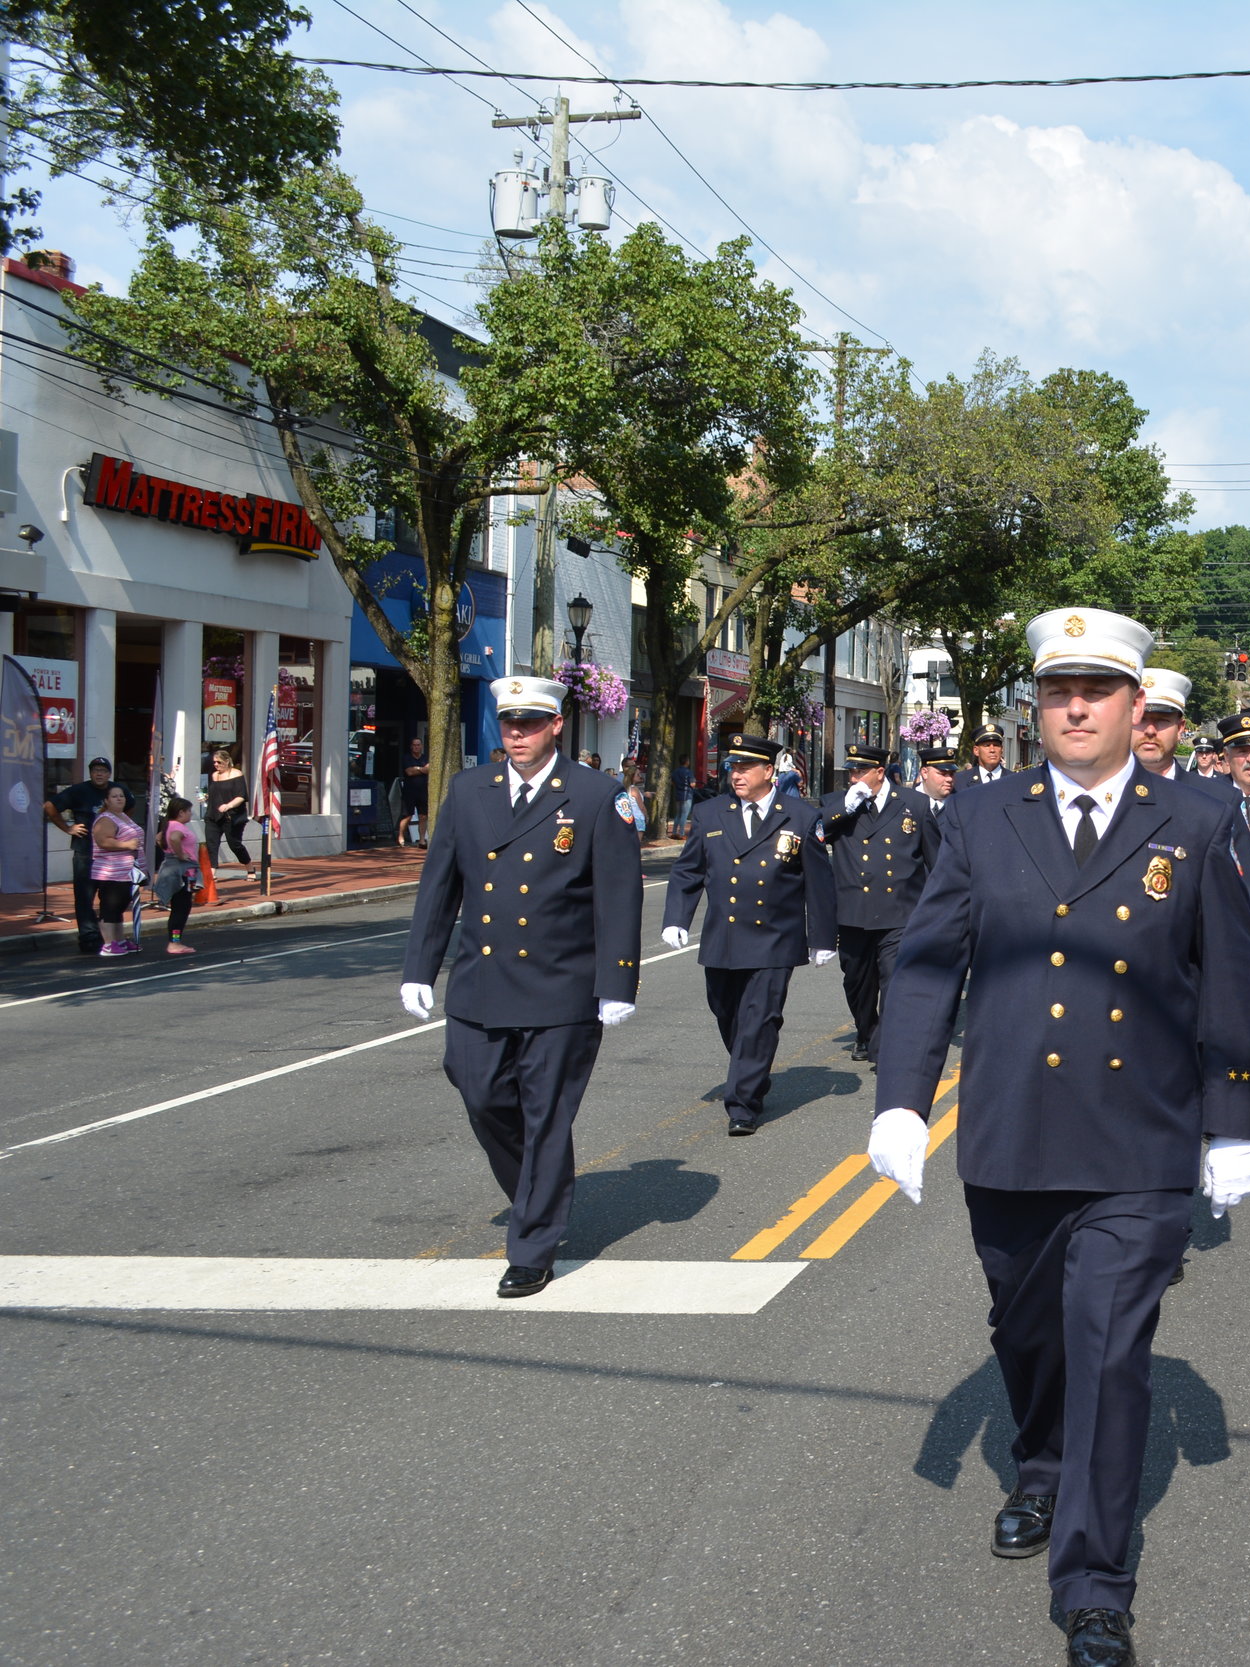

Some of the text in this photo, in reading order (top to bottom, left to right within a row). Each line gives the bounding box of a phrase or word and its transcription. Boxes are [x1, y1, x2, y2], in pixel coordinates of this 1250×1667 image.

[464, 652, 482, 665] GRILL
[33, 667, 50, 675] POWER
[31, 674, 62, 691] SALE
[214, 691, 229, 701] FIRM
[207, 712, 235, 731] OPEN
